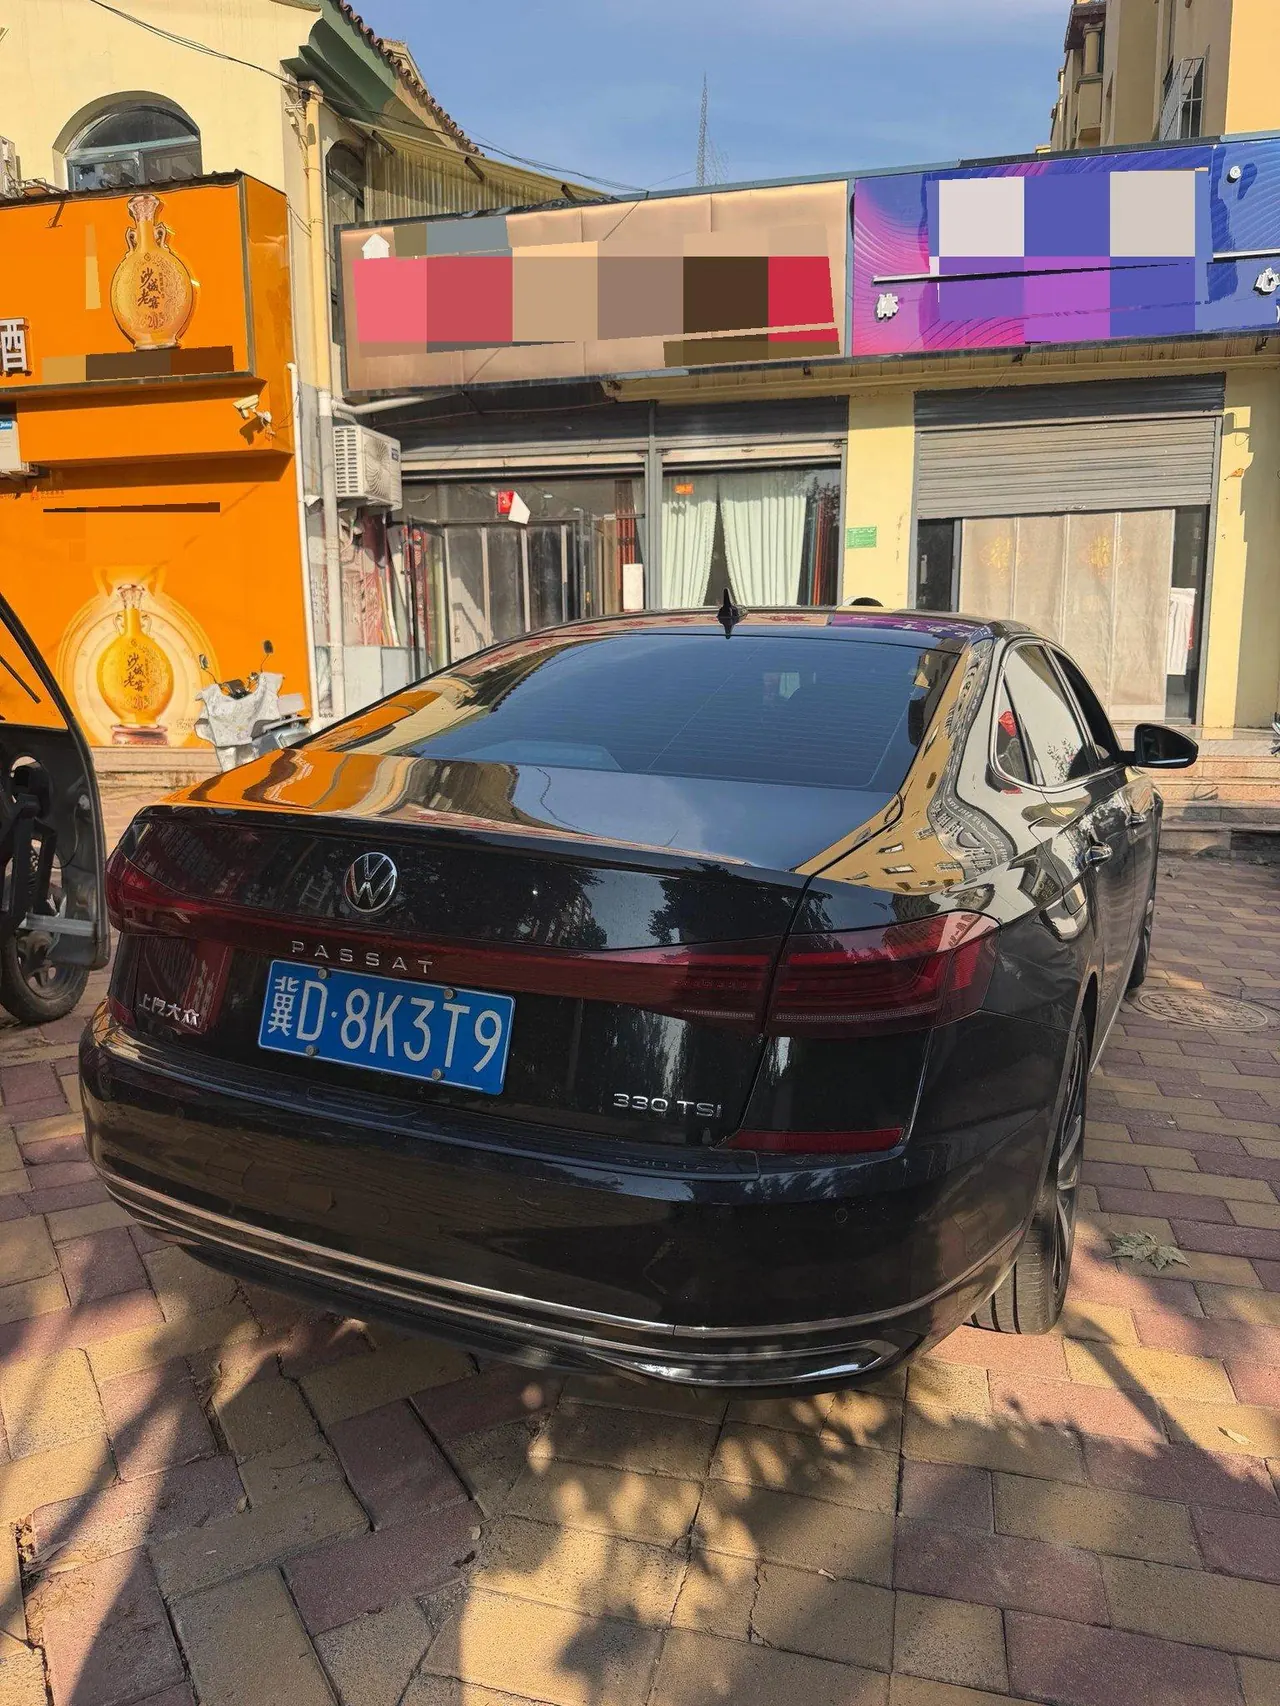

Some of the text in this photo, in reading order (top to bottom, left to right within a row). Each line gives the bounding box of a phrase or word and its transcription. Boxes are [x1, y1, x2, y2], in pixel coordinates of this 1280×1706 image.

[291, 940, 433, 974] PASSAT
[138, 993, 200, 1028] 上汽大众
[613, 1093, 722, 1118] 330 TSI
